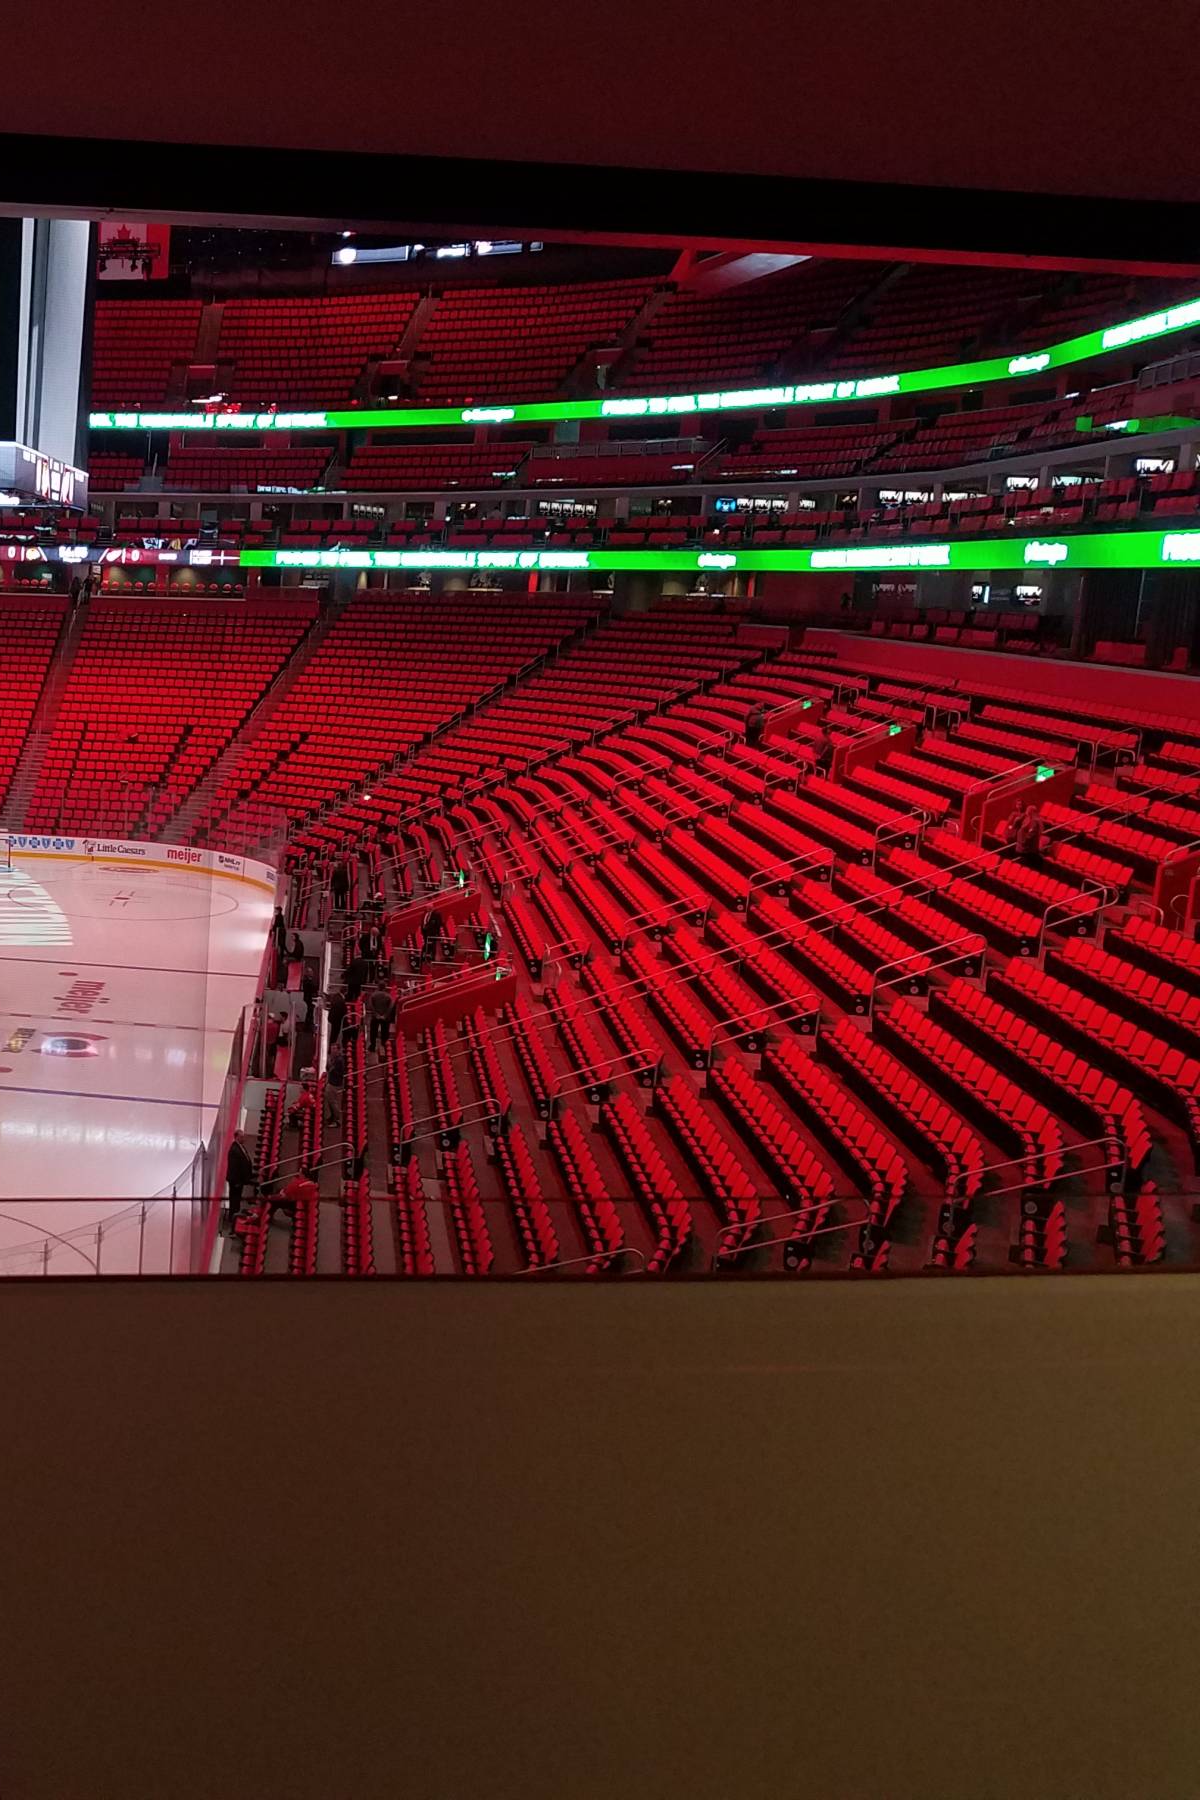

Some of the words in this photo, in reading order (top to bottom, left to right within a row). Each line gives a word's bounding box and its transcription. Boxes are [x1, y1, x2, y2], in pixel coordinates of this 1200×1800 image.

[97, 843, 117, 853] Little
[117, 845, 145, 856] Caesars
[167, 848, 202, 864] meijer
[53, 980, 110, 1014] meijer
